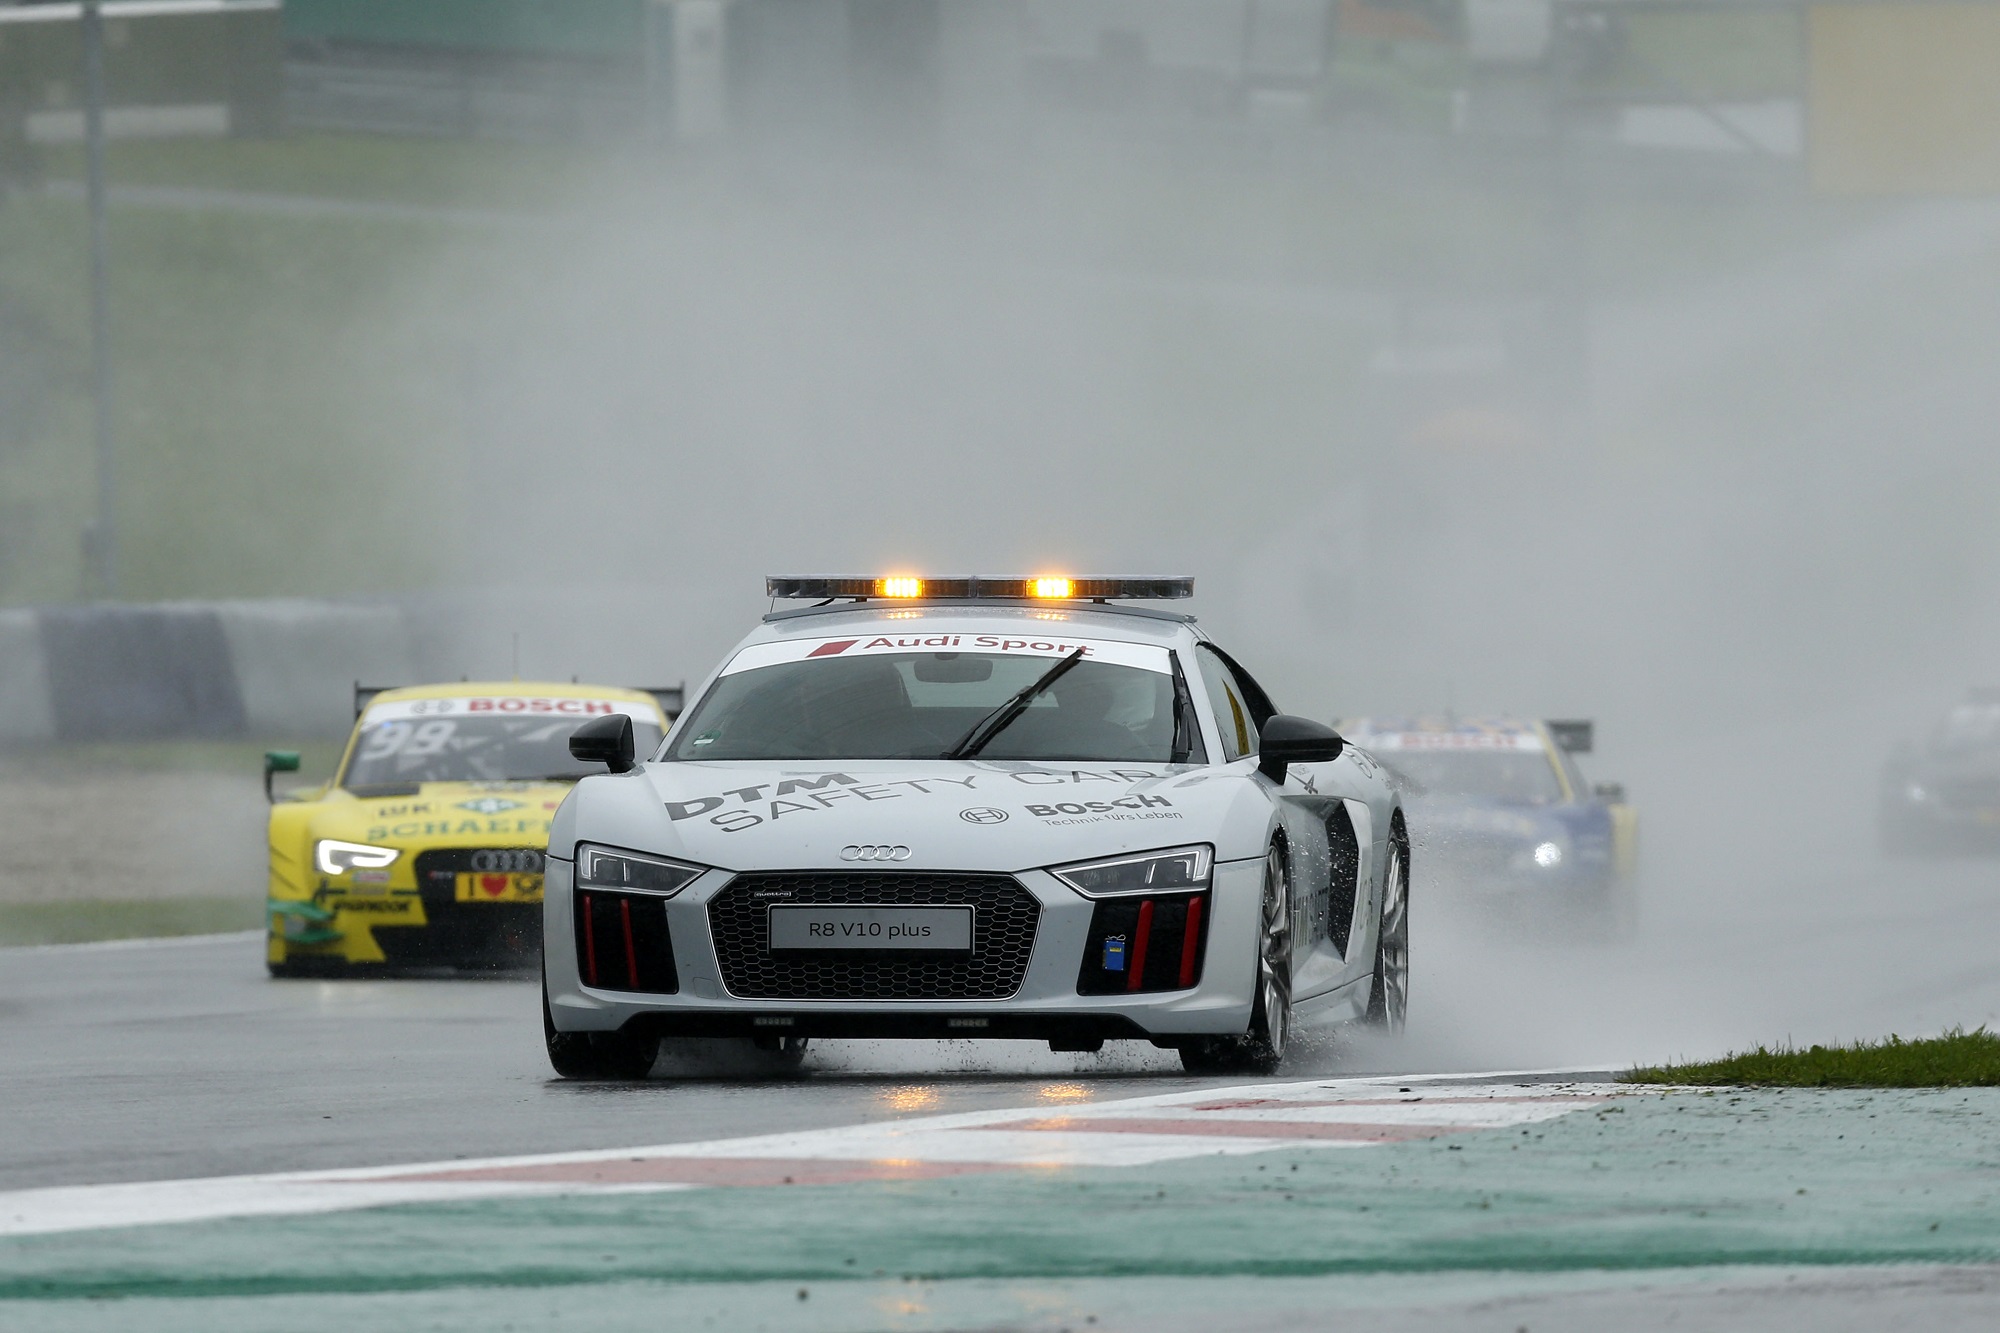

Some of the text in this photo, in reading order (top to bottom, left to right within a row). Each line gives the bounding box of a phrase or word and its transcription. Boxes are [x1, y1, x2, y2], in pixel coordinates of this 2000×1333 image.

[863, 635, 1095, 657] Audi Sport
[468, 699, 615, 715] BOSCH
[363, 720, 457, 761] 99
[664, 772, 860, 821] DTM
[709, 775, 977, 833] SAFETY
[1023, 794, 1173, 817] BOSCH
[1041, 811, 1184, 827] Technik fürs Leben
[809, 921, 931, 940] R8 V10 plus
